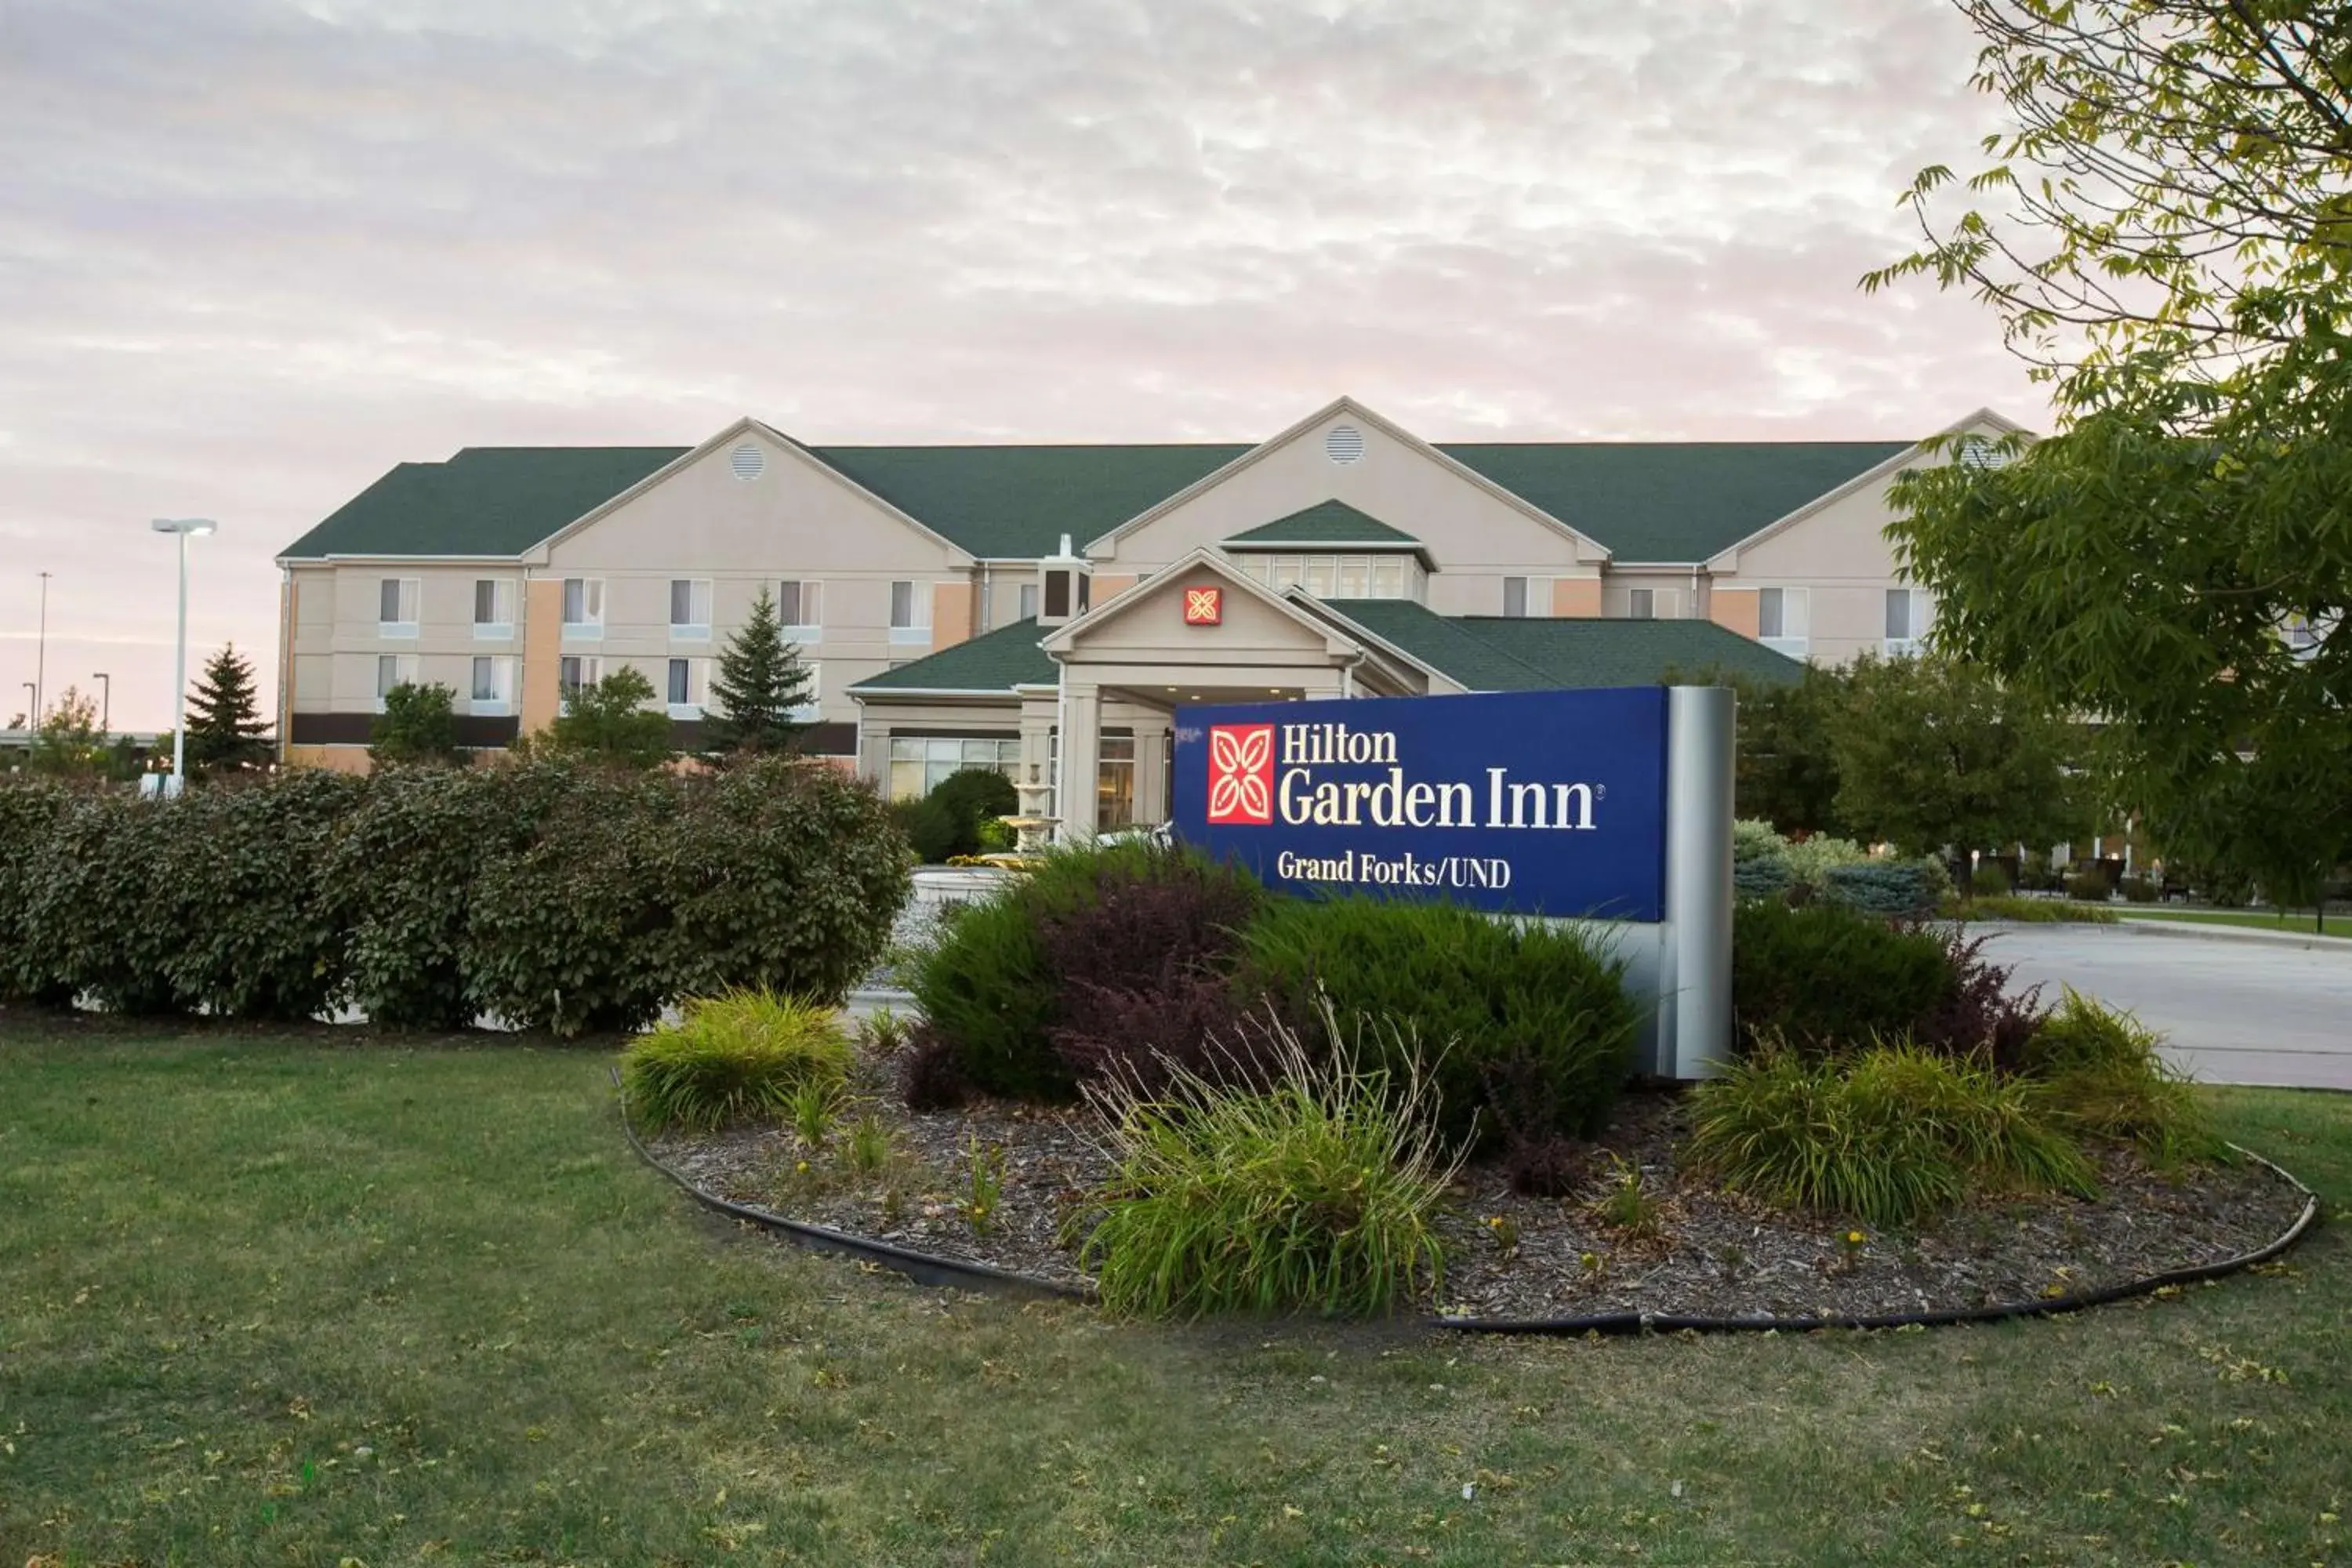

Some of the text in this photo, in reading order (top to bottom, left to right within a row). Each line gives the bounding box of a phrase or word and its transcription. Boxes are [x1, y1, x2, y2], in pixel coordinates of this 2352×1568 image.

[1283, 724, 1397, 764] Hilton
[1279, 768, 1595, 829] Garden Inn
[1278, 851, 1510, 887] Grand Forks/UND
